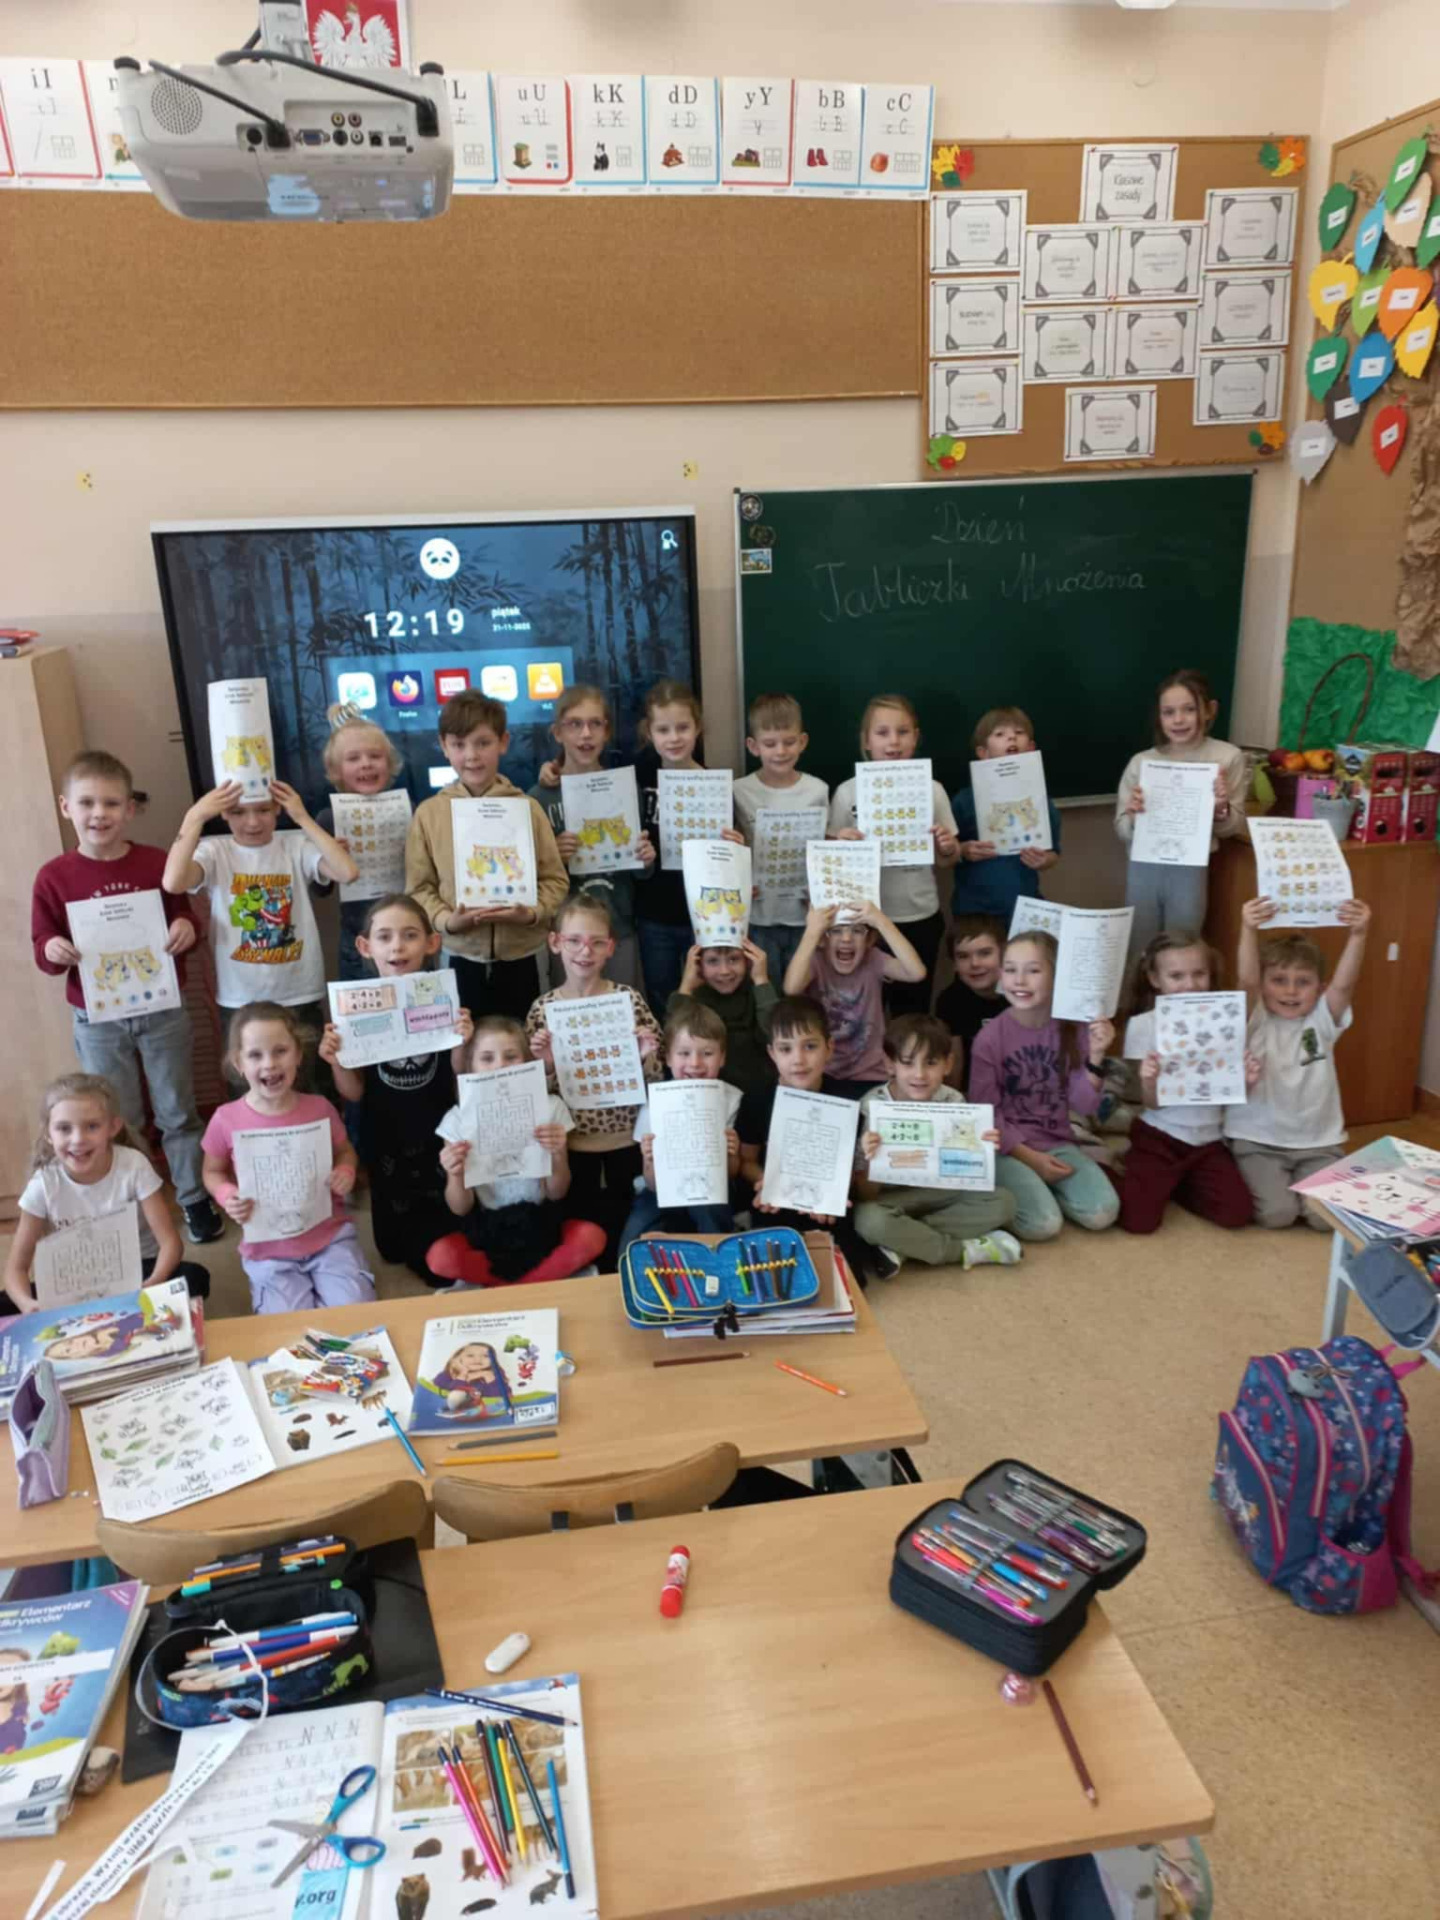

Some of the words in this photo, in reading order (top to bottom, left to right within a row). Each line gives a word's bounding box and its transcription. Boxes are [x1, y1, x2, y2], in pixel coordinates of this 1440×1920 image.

[931, 495, 1026, 545] Dzień
[815, 556, 972, 622] Tabliczki
[1002, 551, 1147, 604] Mnożenia
[364, 607, 465, 639] 12:19
[21, 1600, 92, 1617] Elementarz
